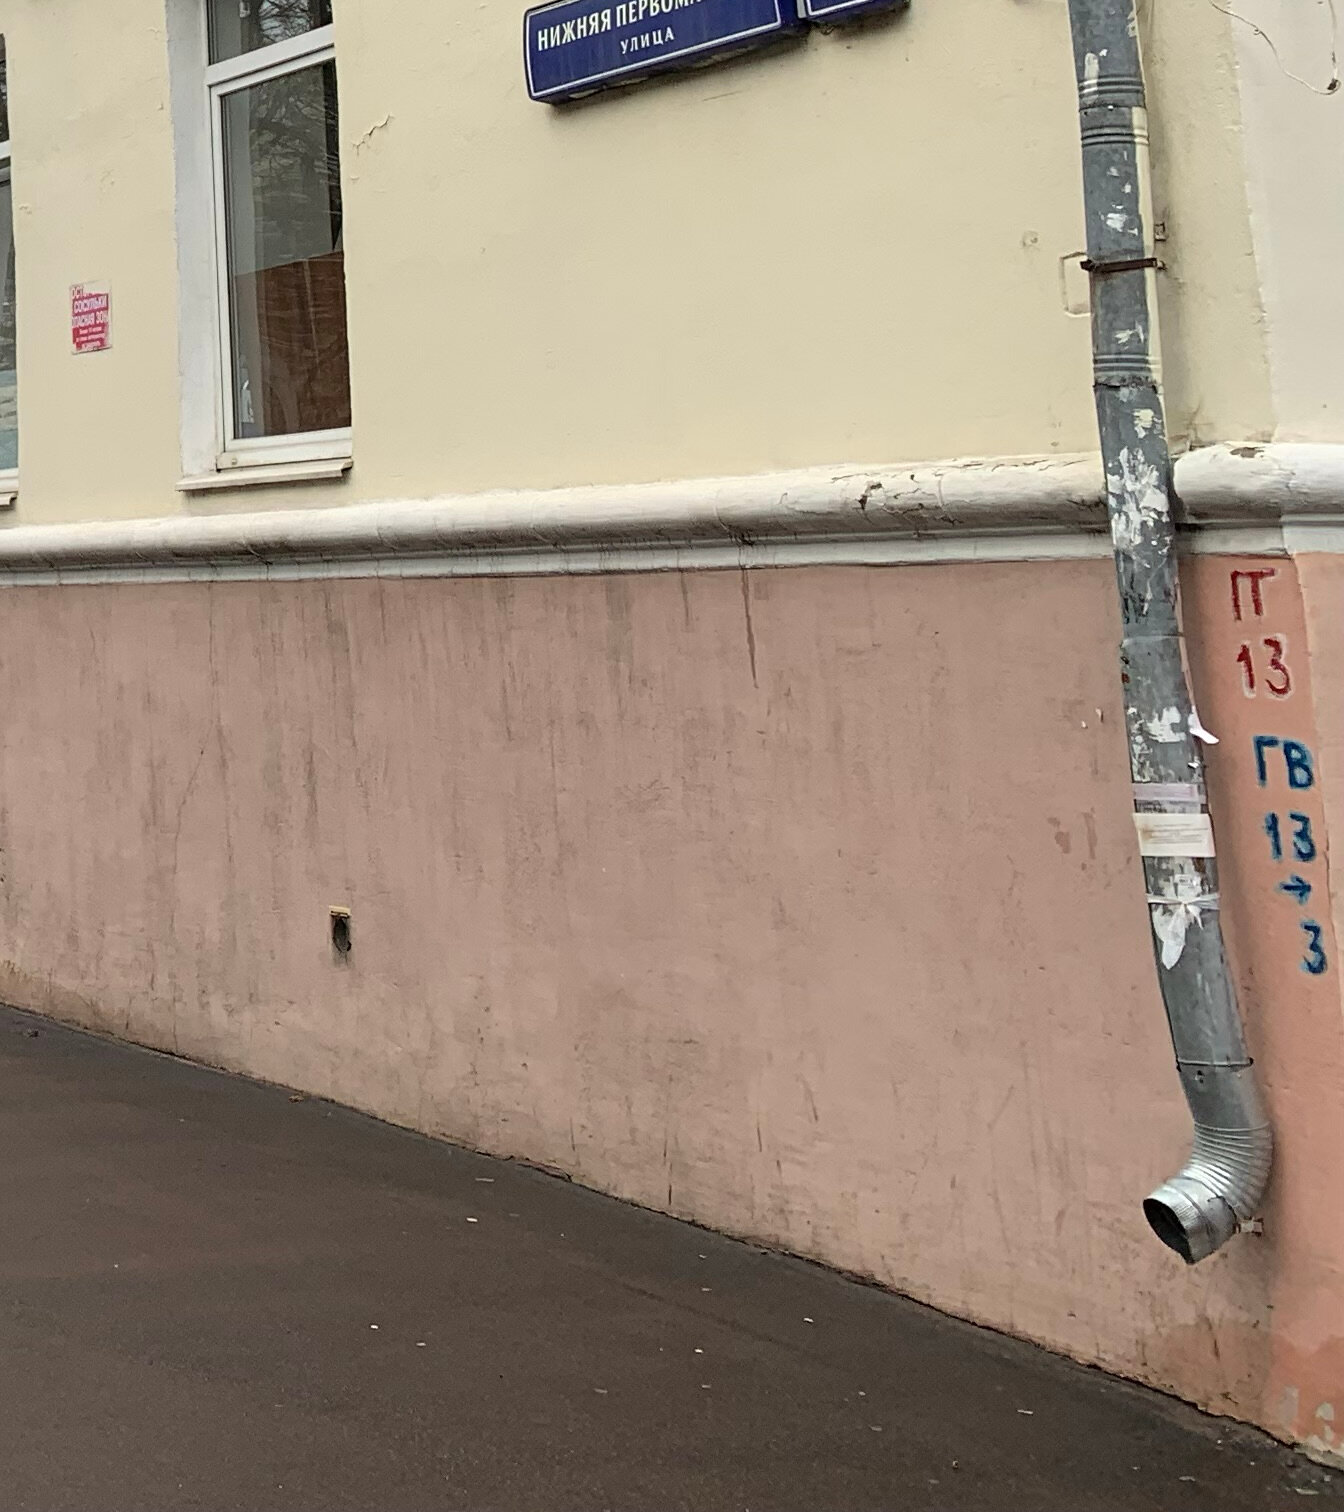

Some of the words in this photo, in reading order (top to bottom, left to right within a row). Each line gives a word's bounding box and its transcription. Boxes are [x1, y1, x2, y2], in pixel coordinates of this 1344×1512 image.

[537, 8, 612, 52] НИЖНЯЯ
[619, 26, 675, 55] УЛИЦА
[1236, 635, 1293, 698] 13
[1253, 734, 1315, 789] ГВ
[1264, 812, 1316, 862] 13
[1299, 920, 1327, 975] 3
